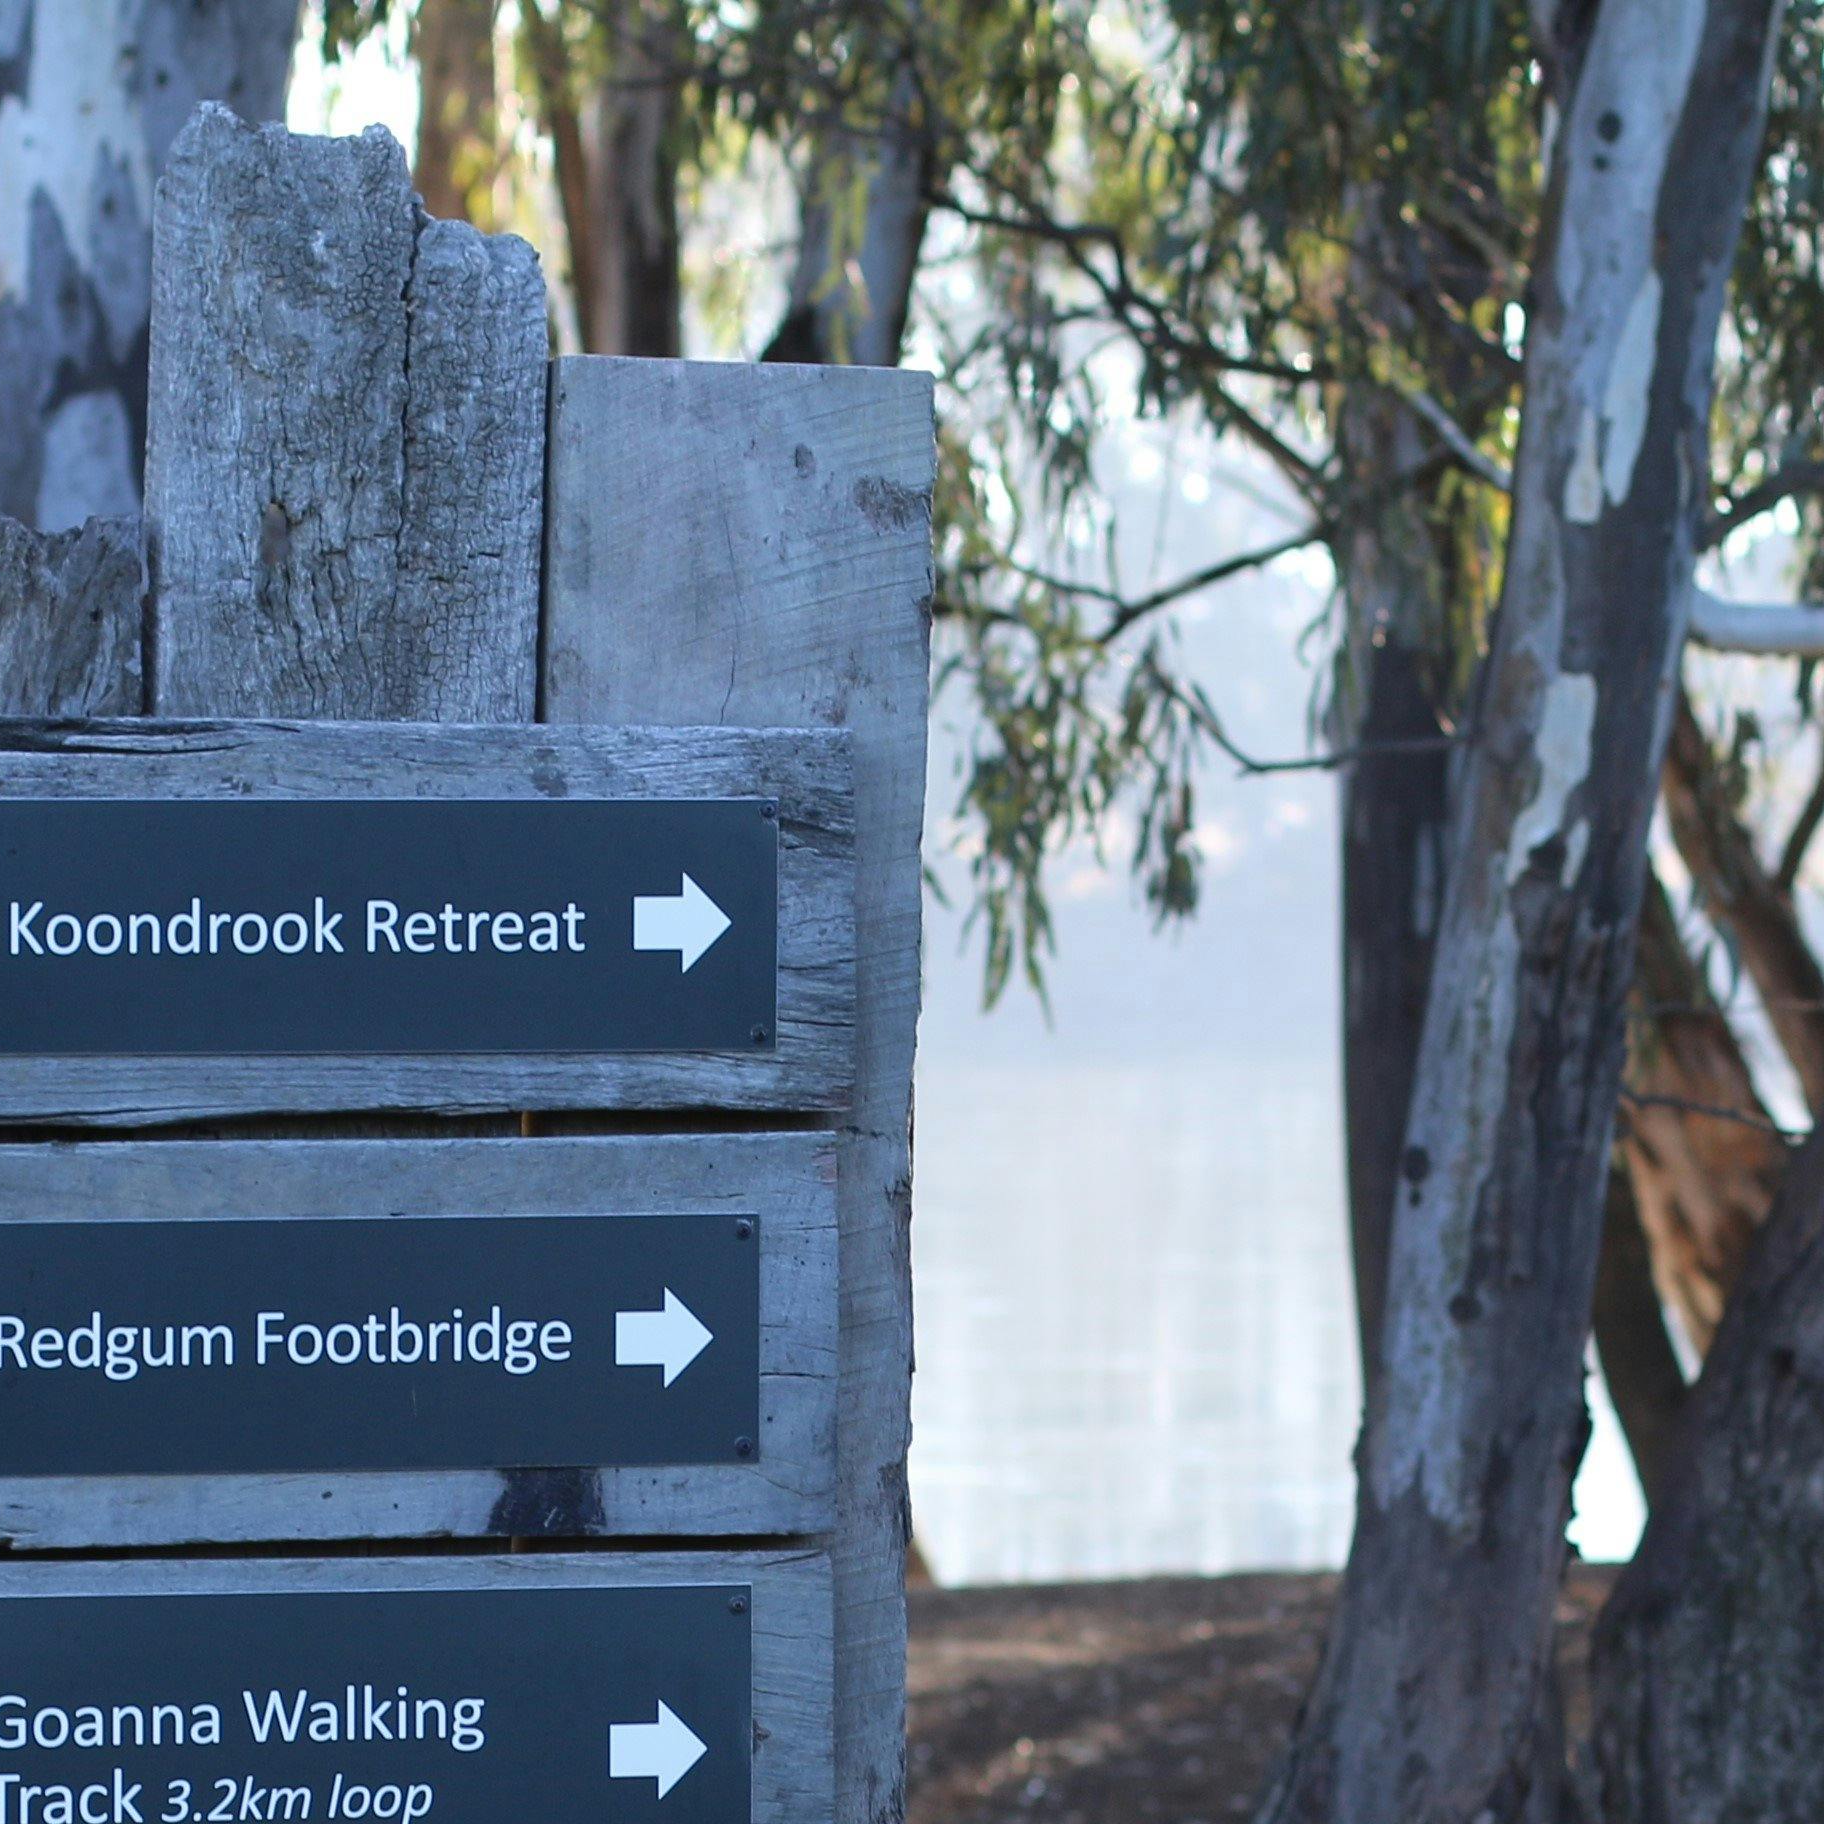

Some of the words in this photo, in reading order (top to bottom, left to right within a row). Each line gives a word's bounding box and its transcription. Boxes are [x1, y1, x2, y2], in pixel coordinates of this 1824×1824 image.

[10, 896, 344, 955] Koondrook
[367, 900, 586, 953] Retreat
[257, 1305, 573, 1374] Footbridge
[241, 1684, 485, 1751] Walking
[161, 1775, 312, 1823] 3.2km
